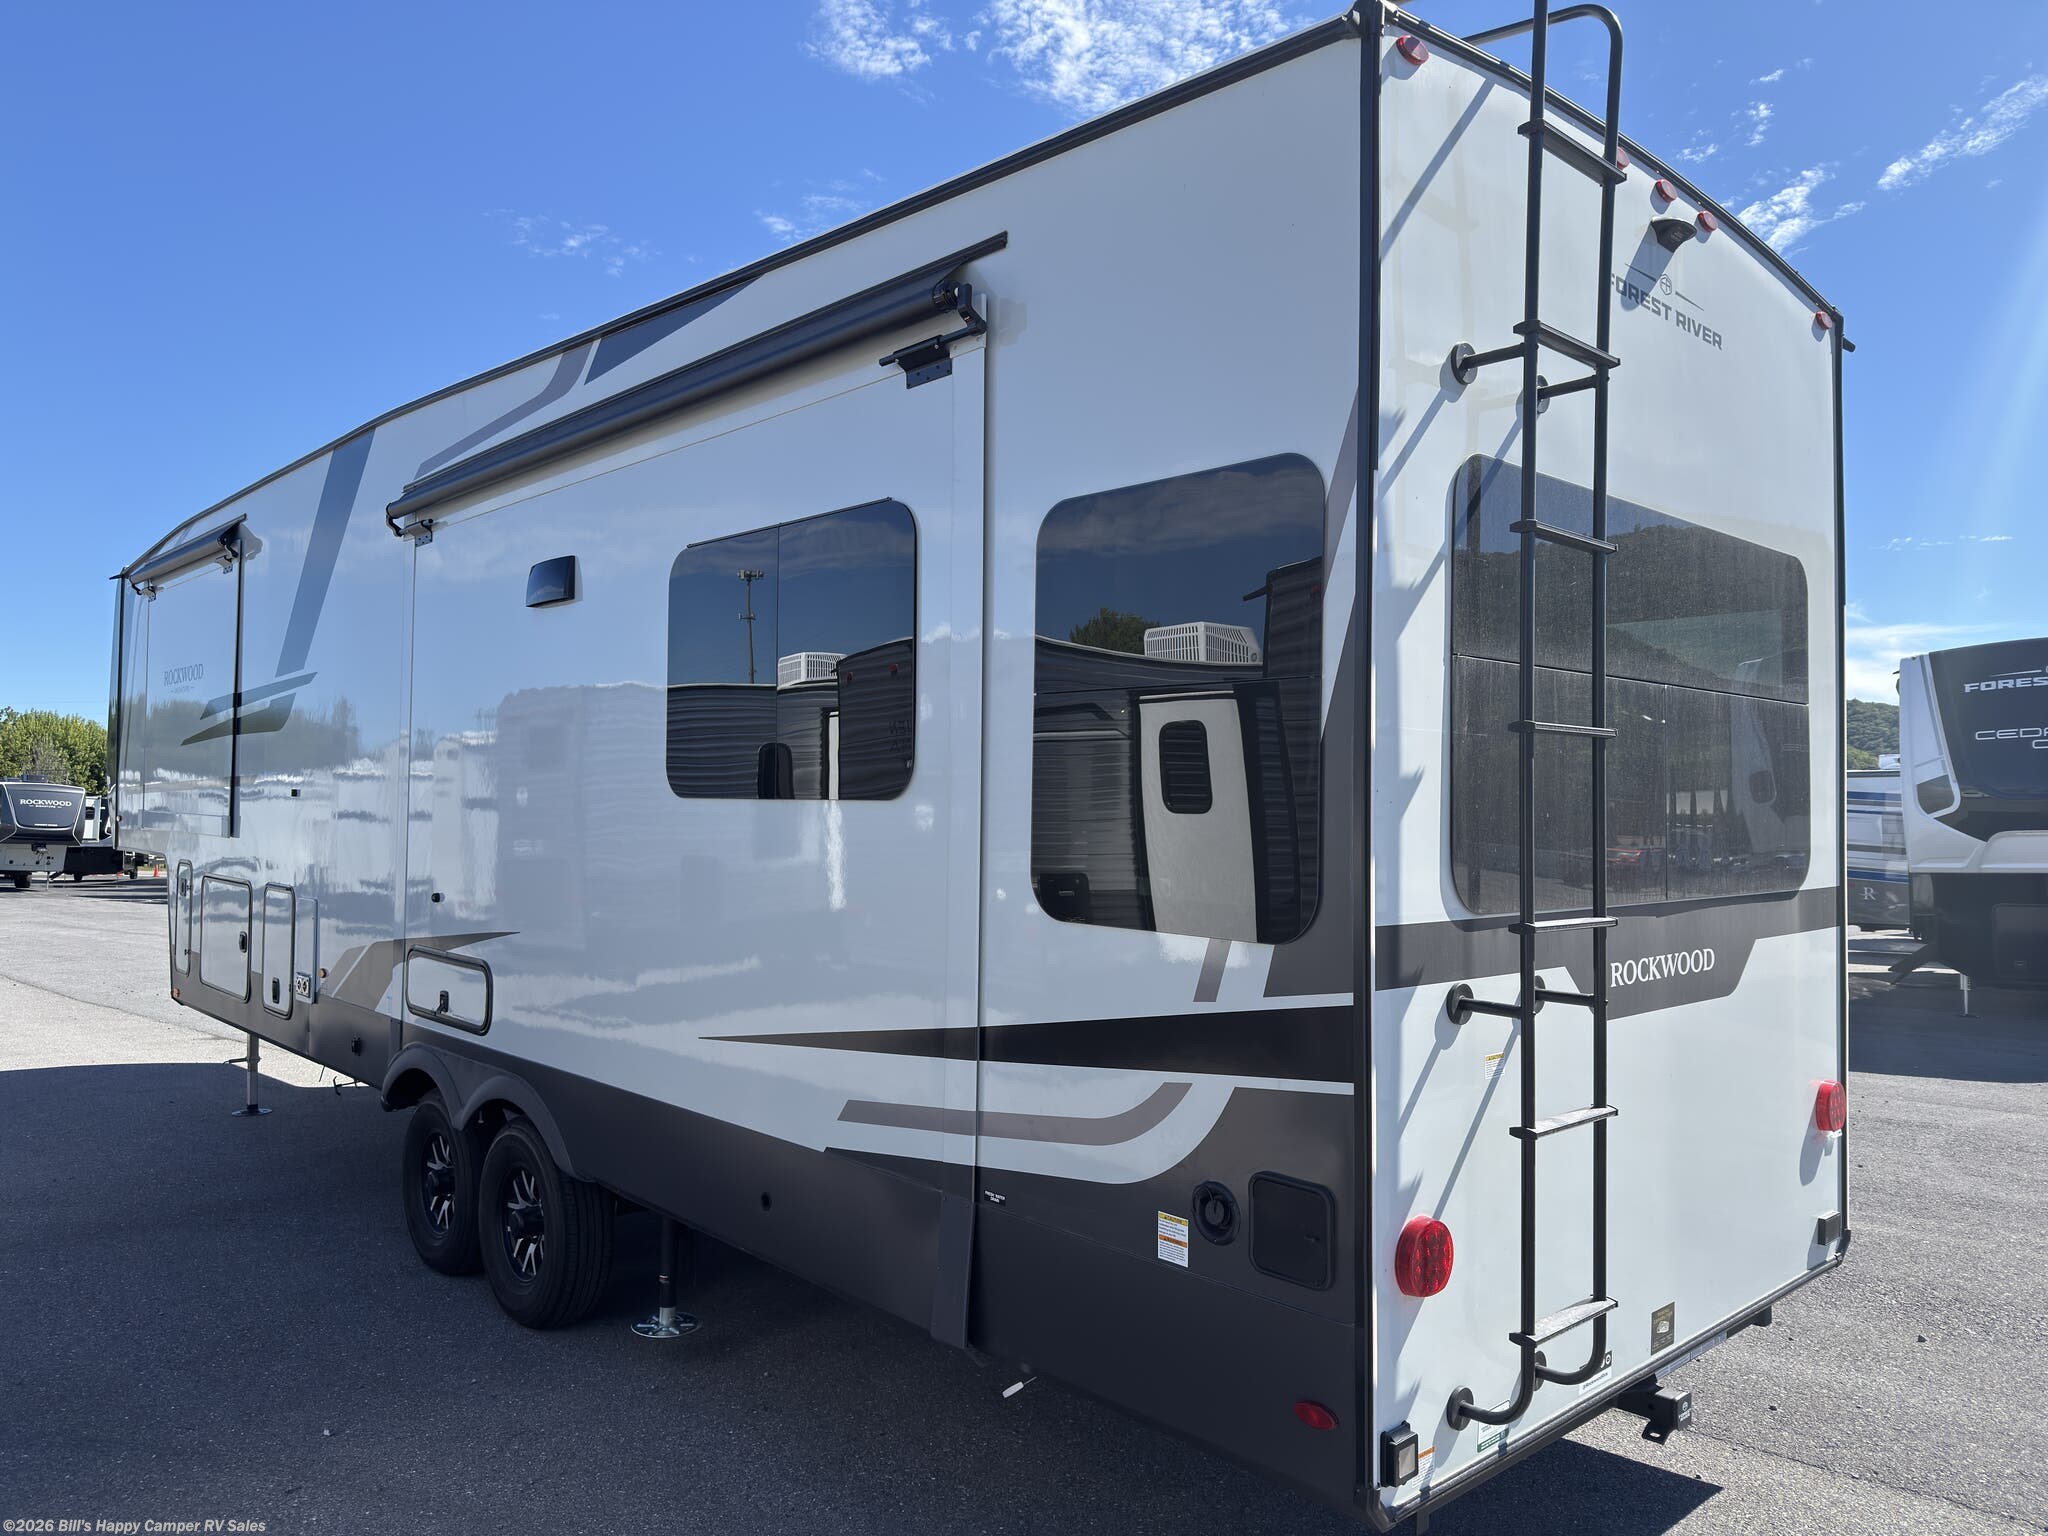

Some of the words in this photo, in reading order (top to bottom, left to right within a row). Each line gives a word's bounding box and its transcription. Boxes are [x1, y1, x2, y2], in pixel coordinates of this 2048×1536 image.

[1675, 310, 1723, 350] RIVER
[163, 664, 204, 687] ROCKWOOD
[1975, 727, 2048, 741] CED
[19, 798, 72, 807] ROCKWOOD
[1610, 948, 1716, 988] ROCKWOOD
